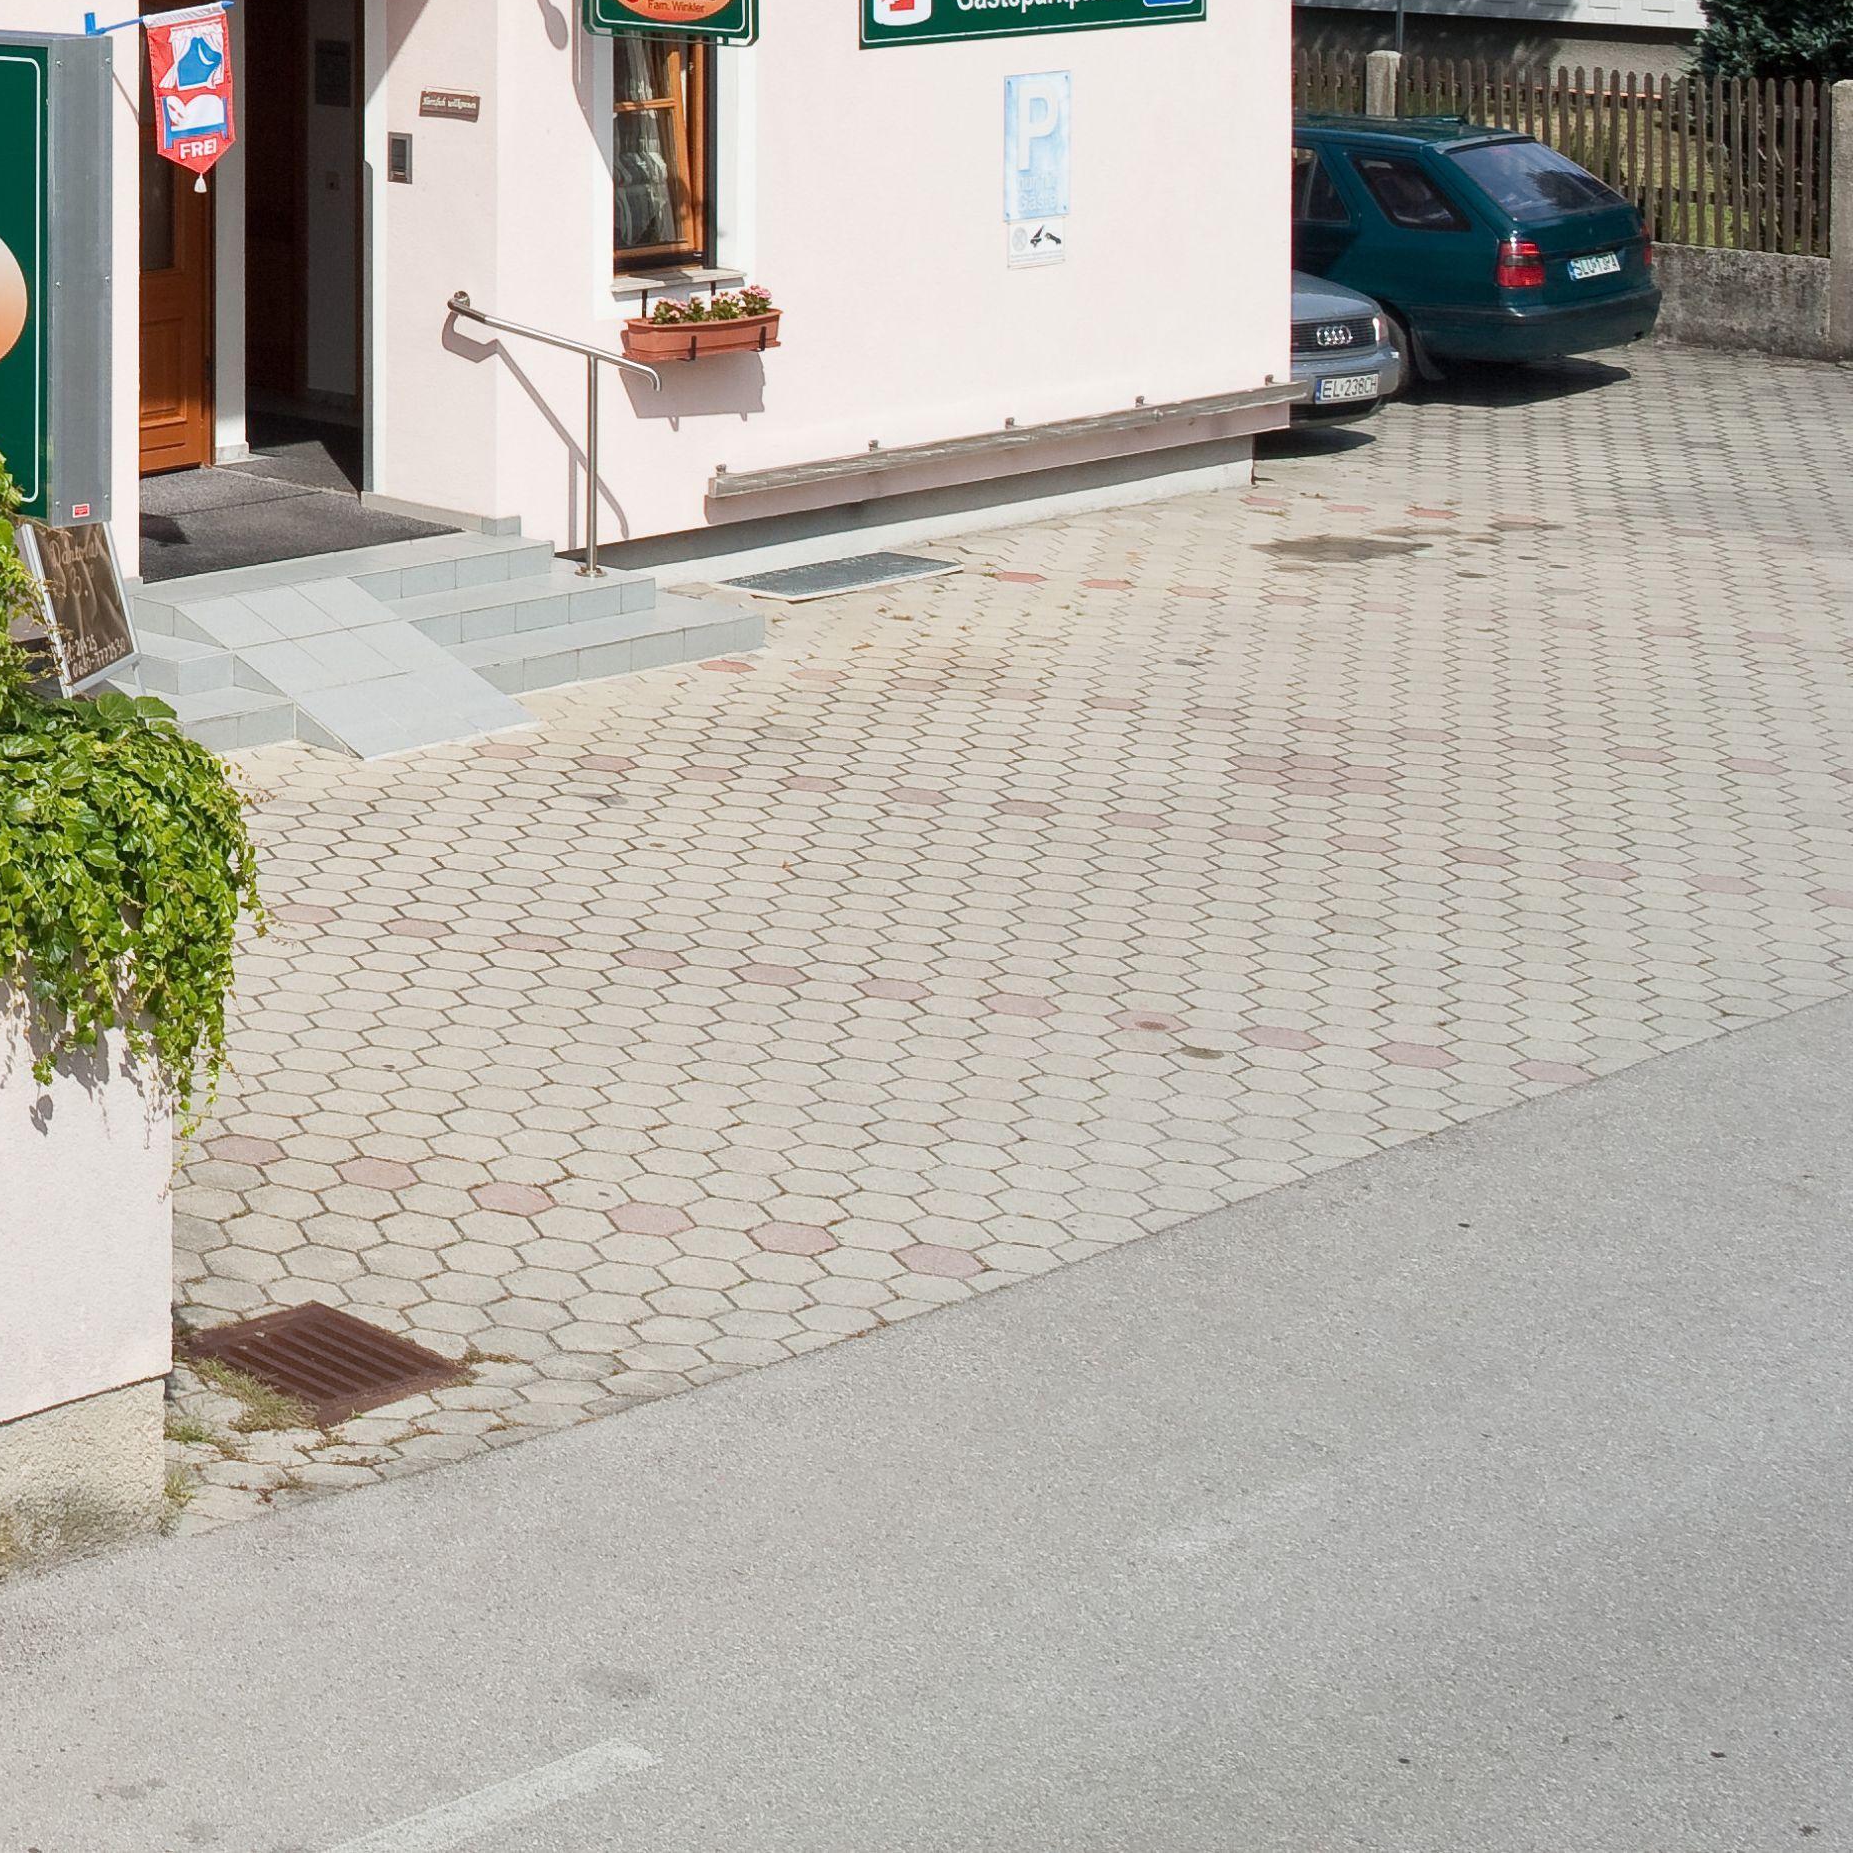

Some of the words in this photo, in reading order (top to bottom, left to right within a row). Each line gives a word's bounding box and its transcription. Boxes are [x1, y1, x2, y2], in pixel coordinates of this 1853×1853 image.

[647, 0, 671, 12] Fam.
[672, 1, 706, 14] Winkler
[1018, 80, 1060, 170] P
[179, 137, 217, 160] FREI
